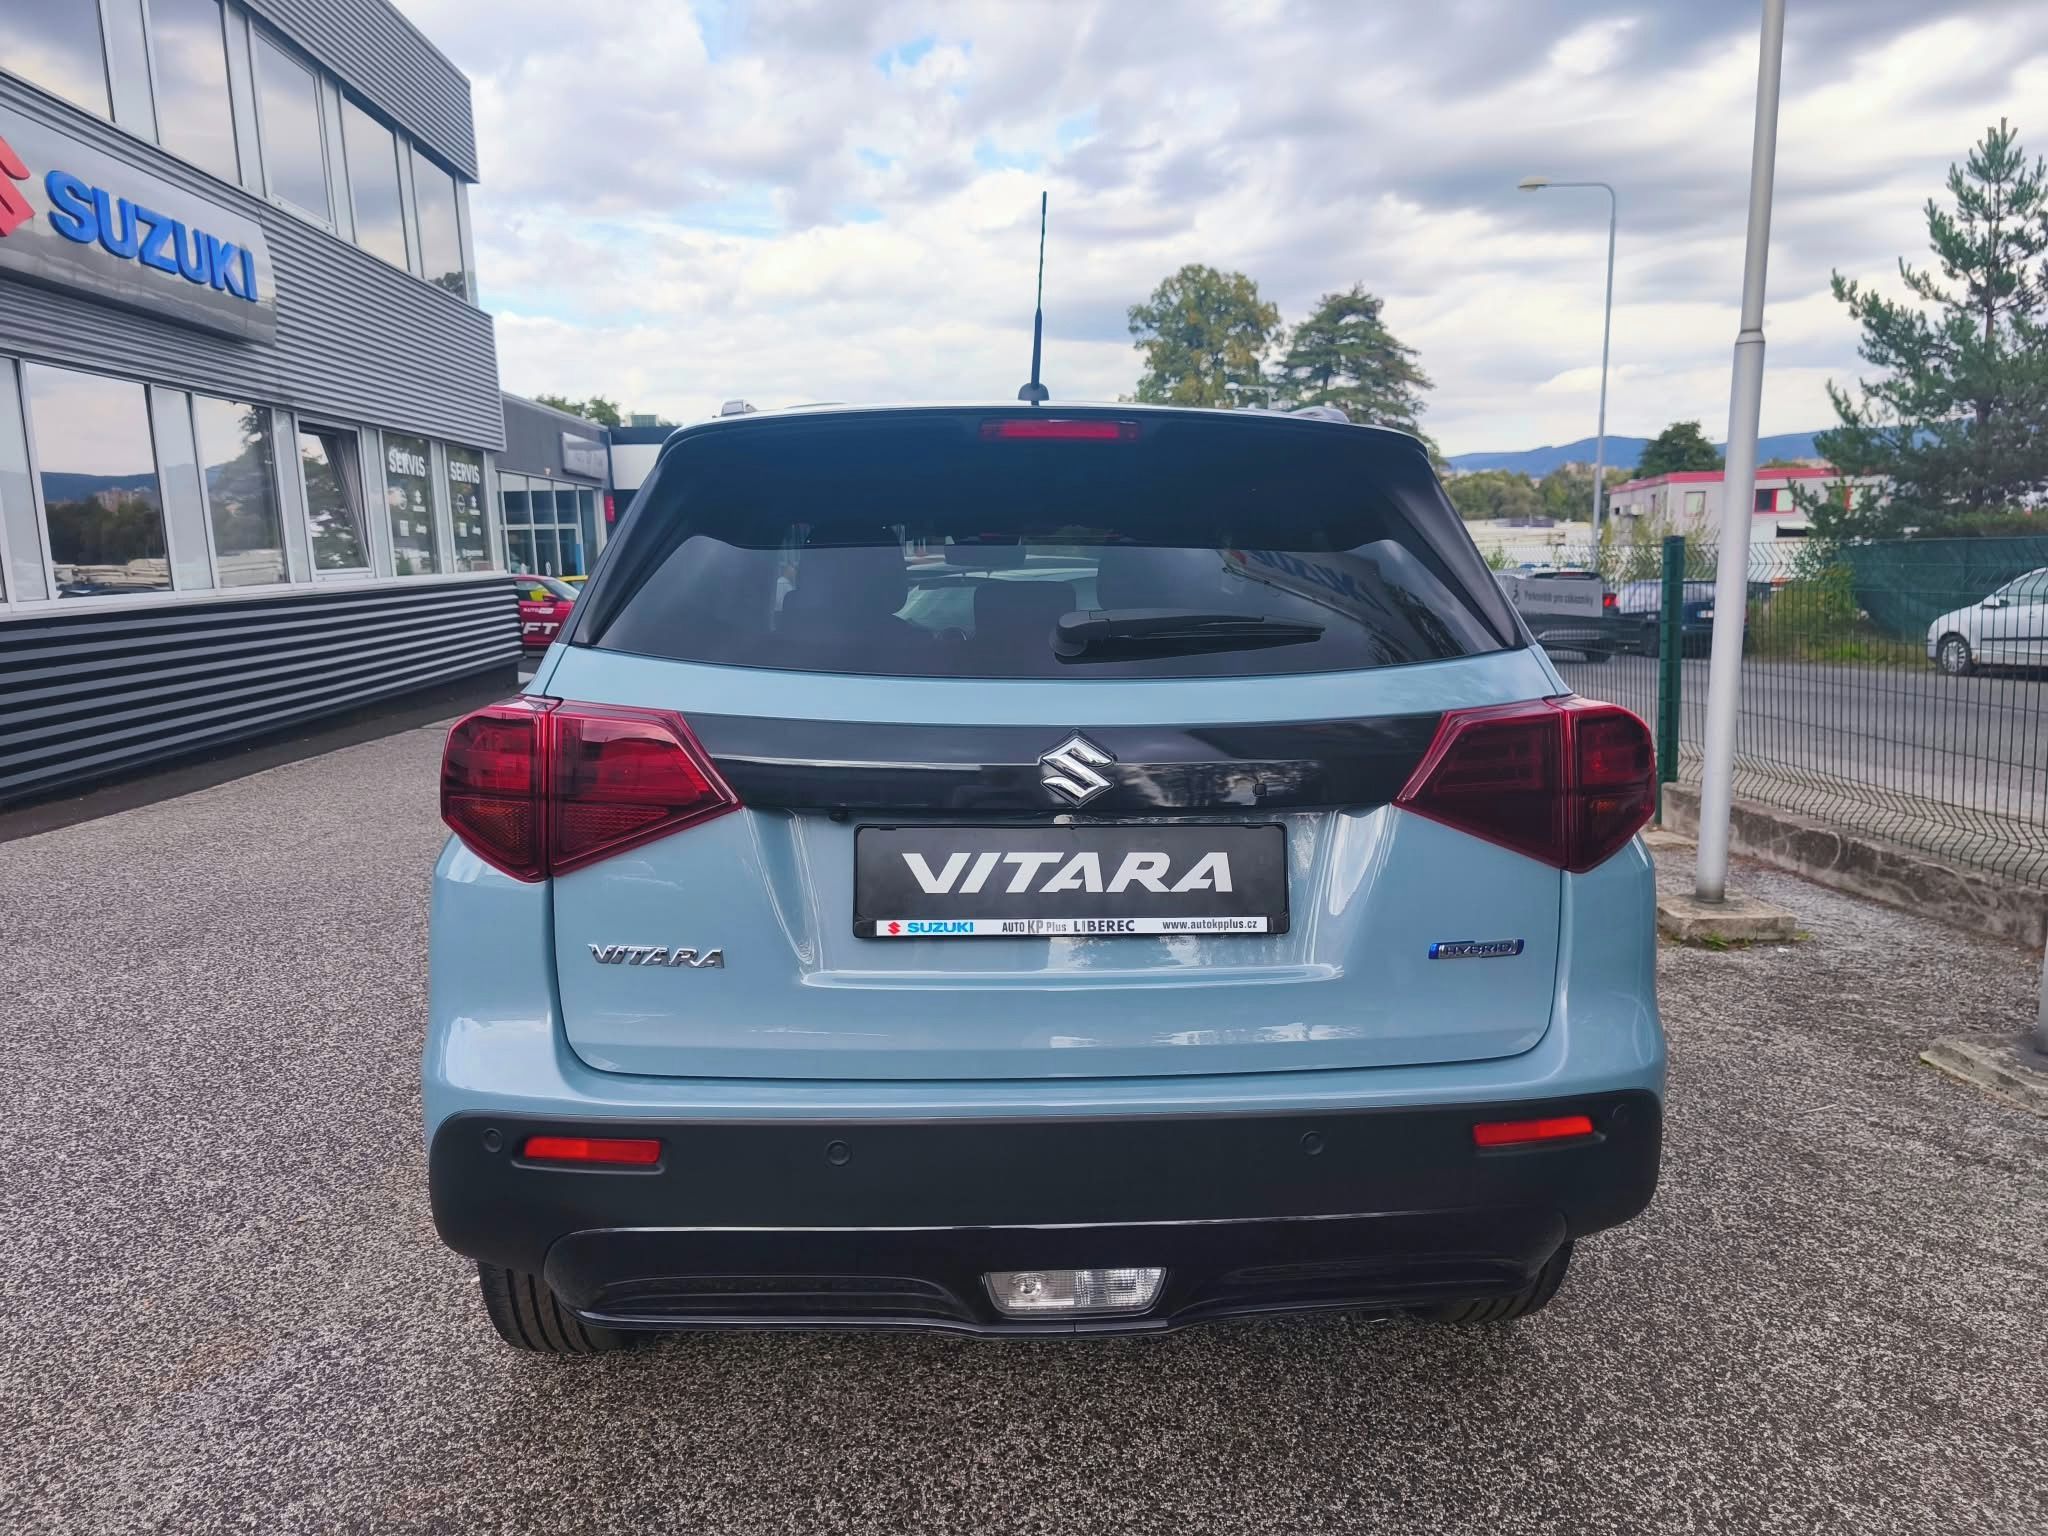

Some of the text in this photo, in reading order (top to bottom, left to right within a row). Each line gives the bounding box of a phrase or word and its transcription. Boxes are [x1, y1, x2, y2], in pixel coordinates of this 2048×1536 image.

[45, 169, 258, 303] SUZUKI
[388, 446, 426, 477] SERVIS
[450, 460, 480, 484] SERVIS
[521, 621, 559, 635] FT
[901, 851, 1233, 894] VITARA
[907, 918, 1257, 934] SUZUKI AUTO KP Plus LIBEREC www.autokpplus.cz
[587, 943, 724, 968] VITARA
